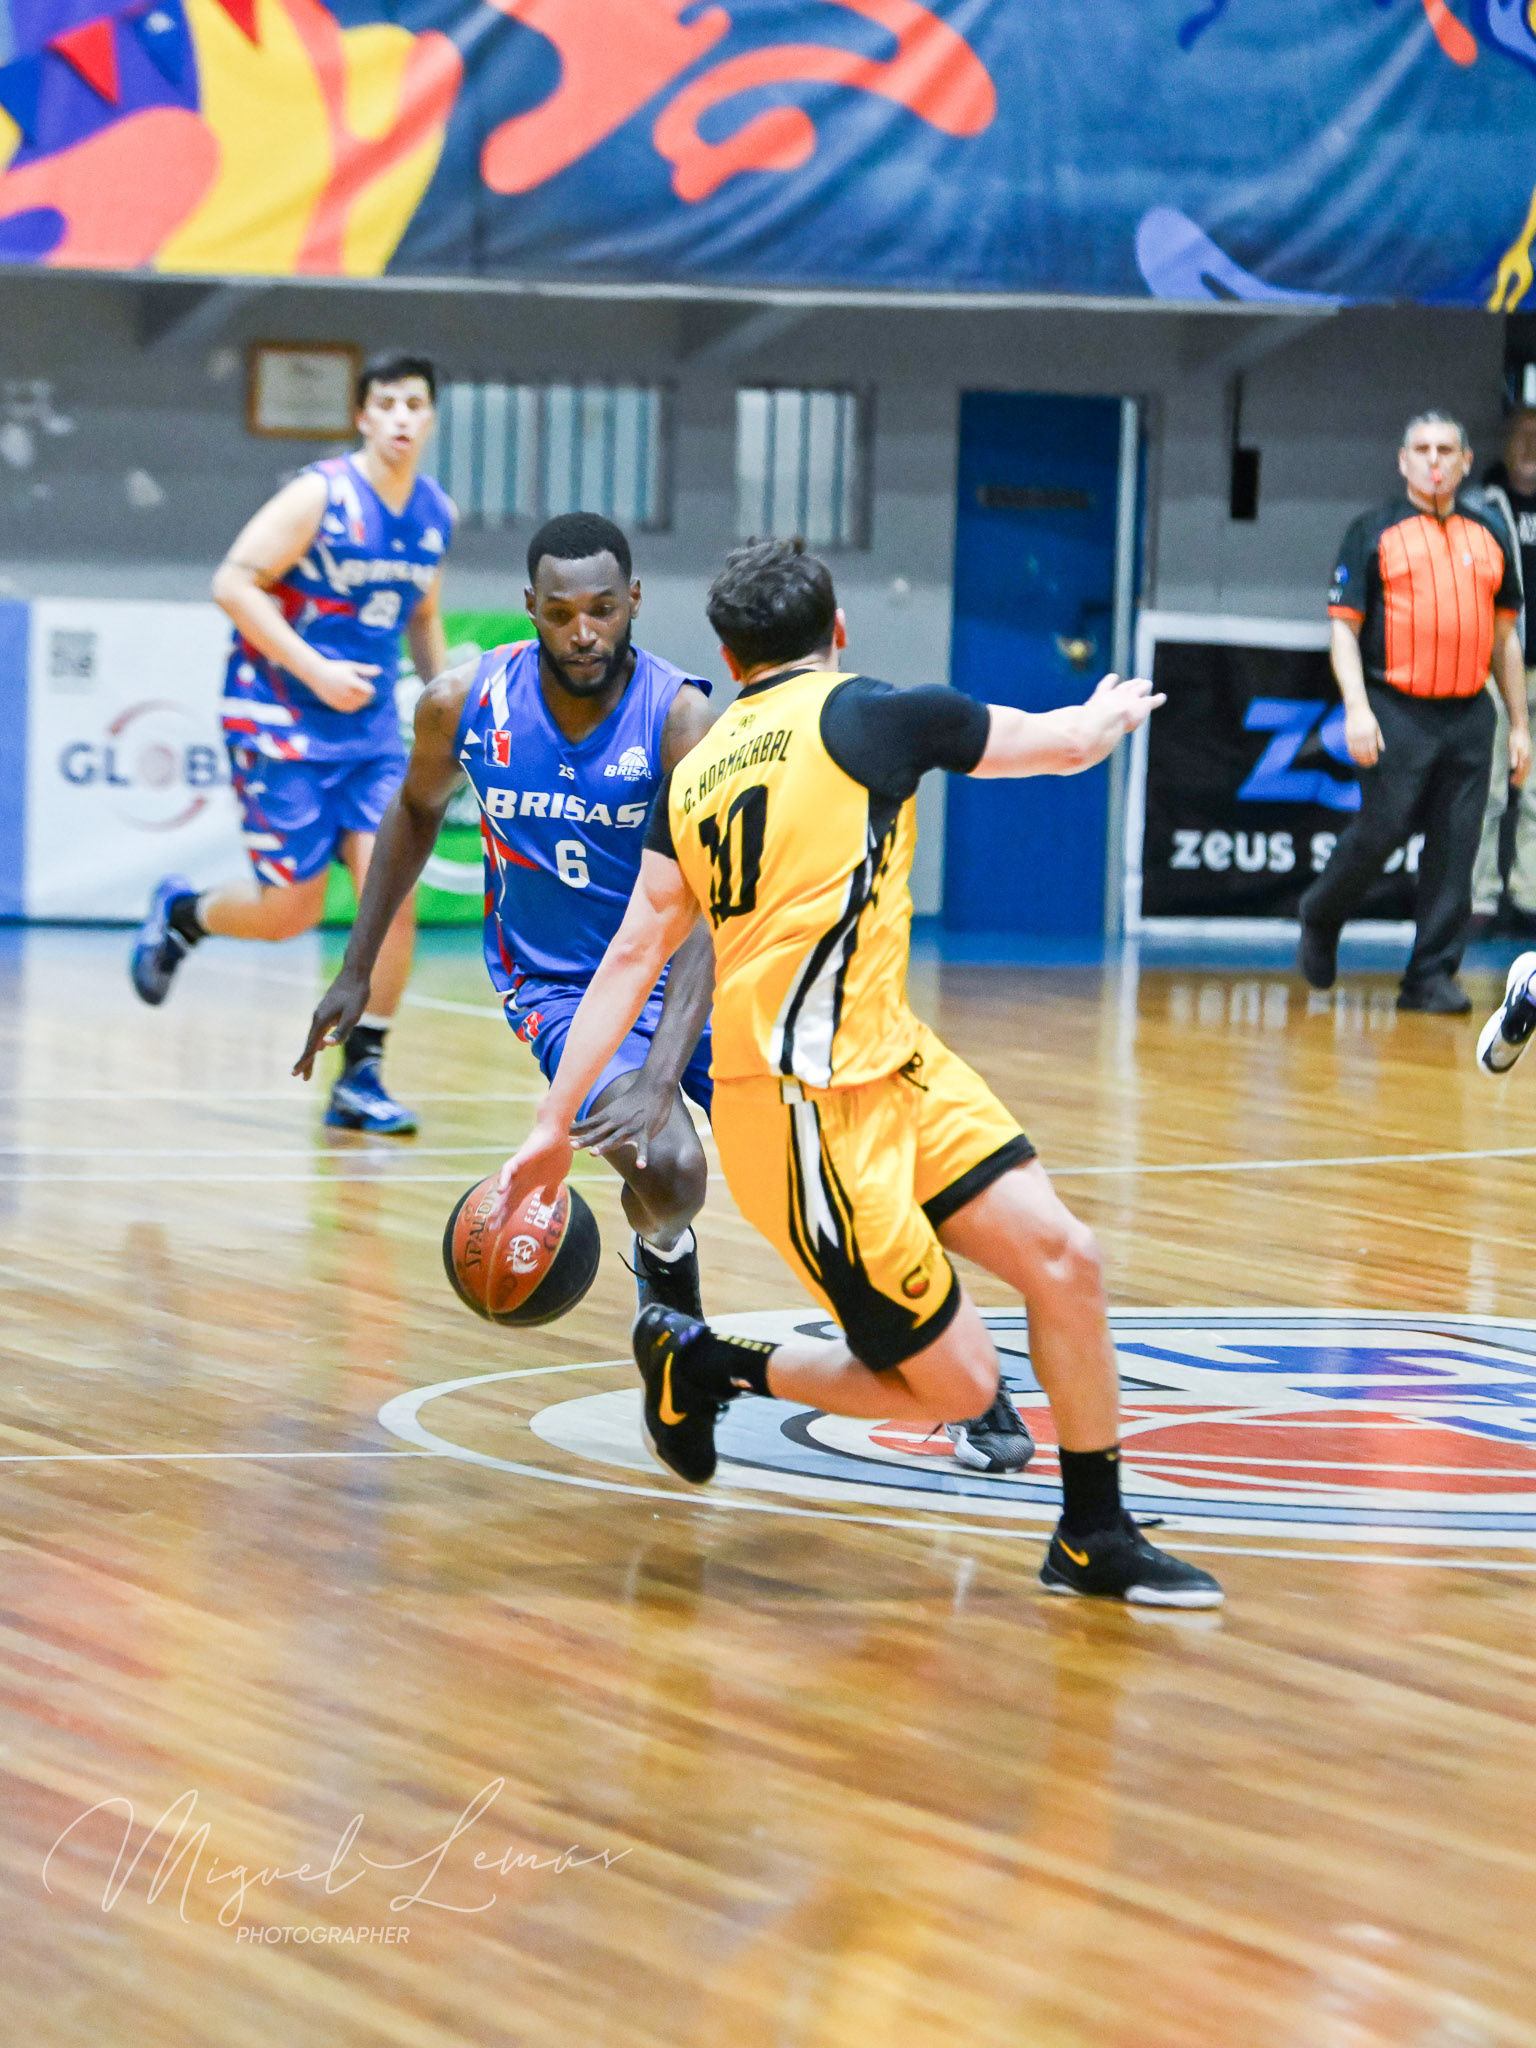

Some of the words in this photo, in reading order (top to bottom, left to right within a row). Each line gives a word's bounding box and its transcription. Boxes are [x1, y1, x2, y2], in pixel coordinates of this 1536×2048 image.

[58, 742, 230, 787] GLOB
[684, 788, 696, 815] G.
[699, 730, 792, 802] HORMAZABAL
[485, 786, 649, 829] BRISAS
[554, 839, 591, 889] 6
[698, 783, 769, 930] 10
